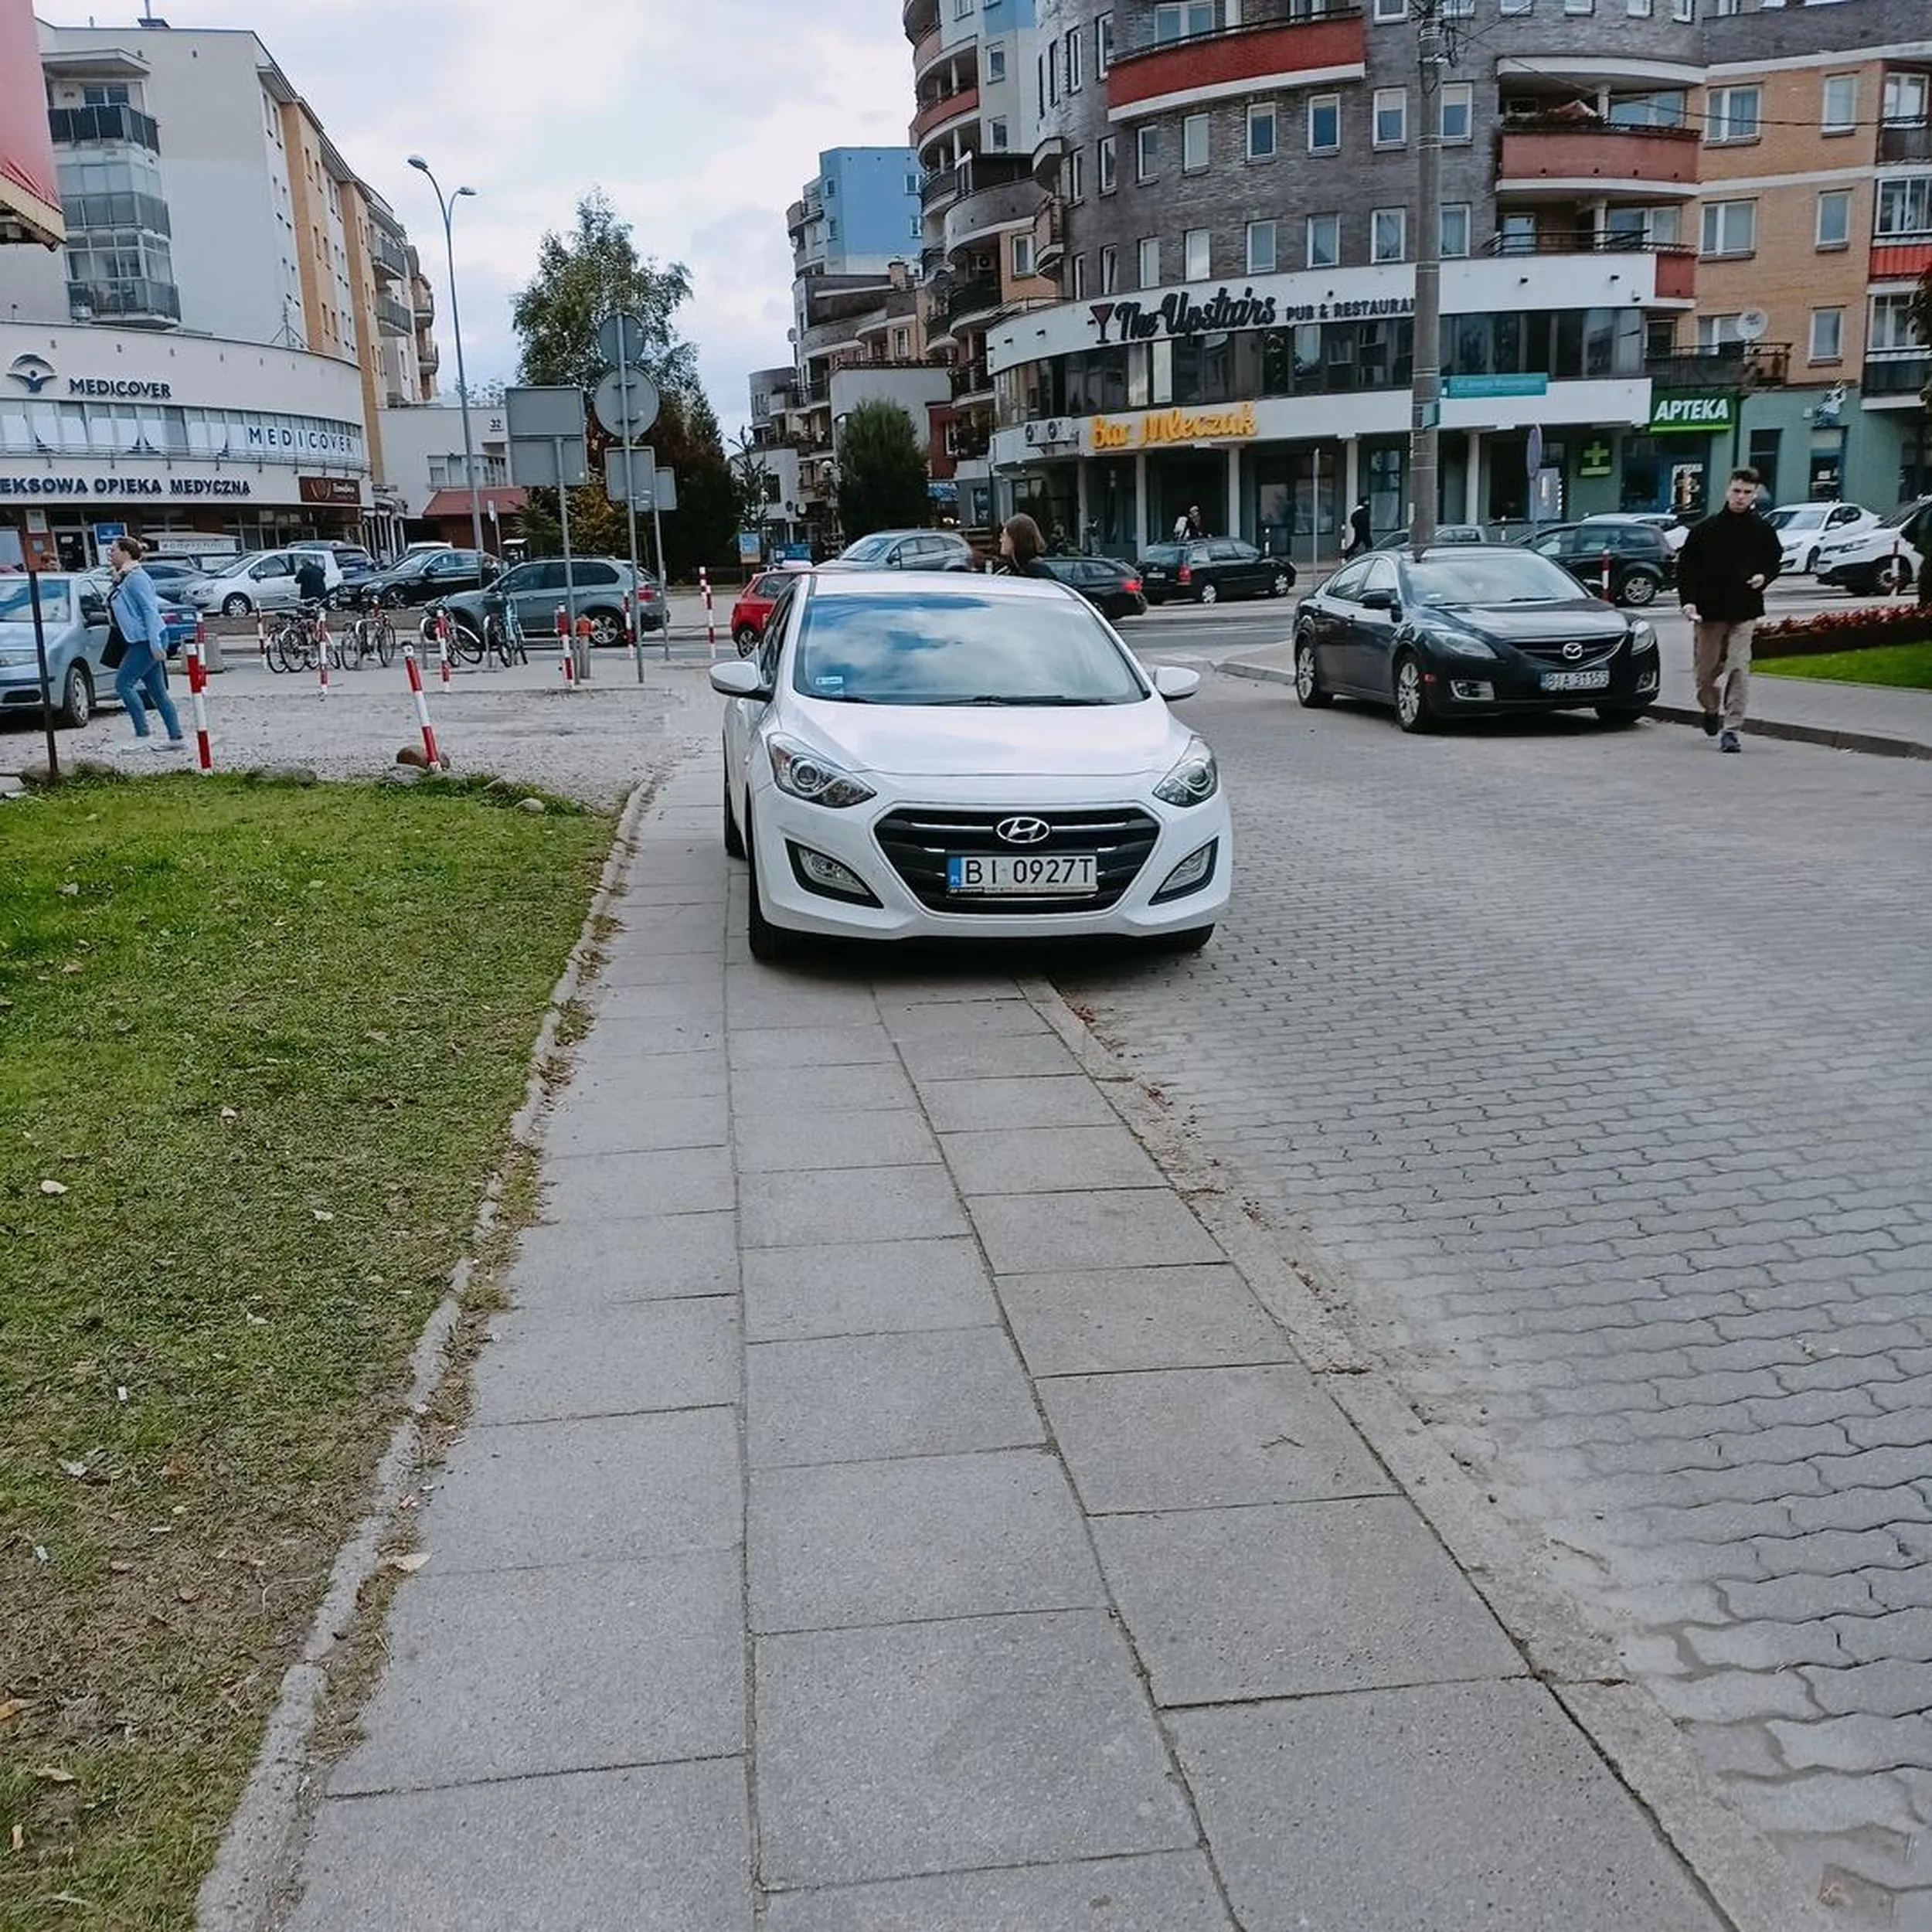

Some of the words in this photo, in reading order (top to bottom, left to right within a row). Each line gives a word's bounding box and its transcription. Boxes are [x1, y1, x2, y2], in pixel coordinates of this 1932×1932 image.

[1115, 302, 1159, 342] The
[1162, 287, 1277, 340] Upstairs
[1287, 304, 1314, 321] PUB
[1318, 303, 1329, 319] &
[69, 378, 172, 399] MEDICOVER
[1654, 399, 1729, 421] APTEKA
[248, 427, 353, 452] MEDICOVER
[94, 478, 162, 495] OPIEKA
[169, 478, 251, 496] MEDYCZNA
[966, 859, 997, 885] BI
[1013, 859, 1094, 885] 0927T
